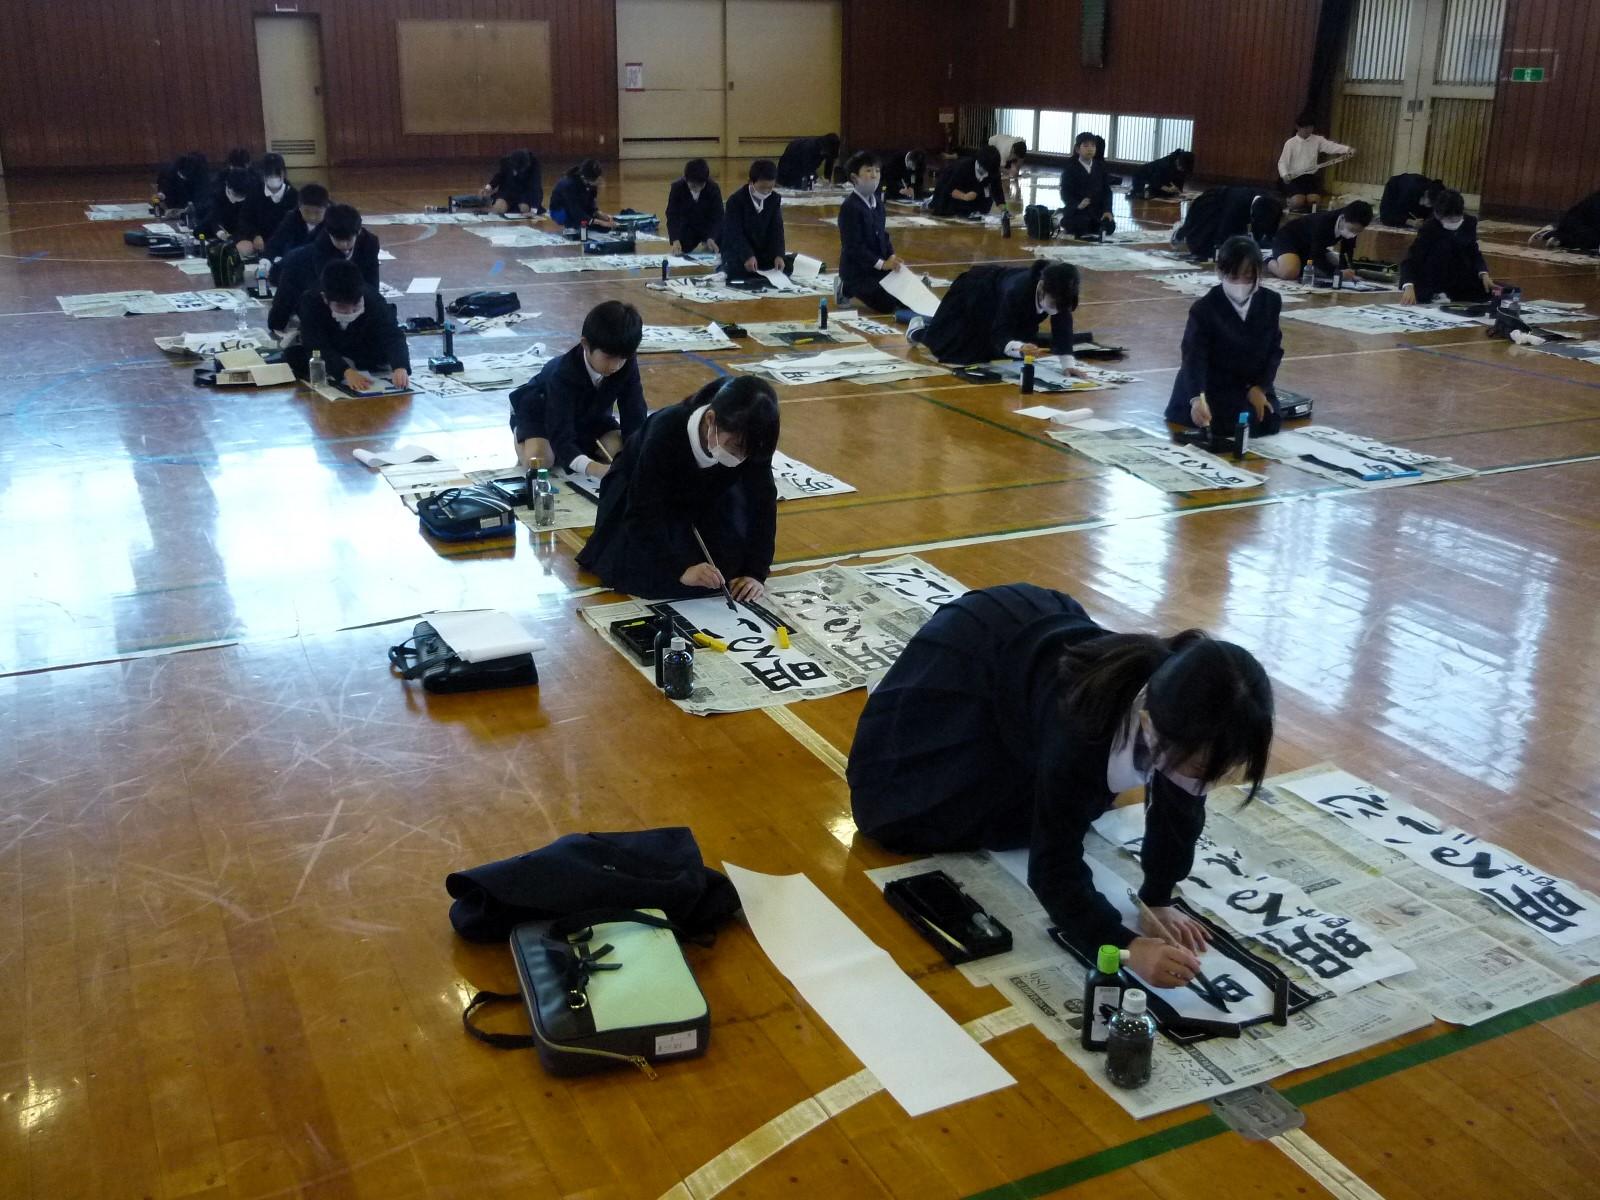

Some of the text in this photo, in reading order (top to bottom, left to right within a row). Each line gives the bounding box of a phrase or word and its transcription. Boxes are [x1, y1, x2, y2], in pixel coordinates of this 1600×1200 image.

[701, 617, 828, 692] 明るい
[1317, 793, 1587, 933] 明るい心
